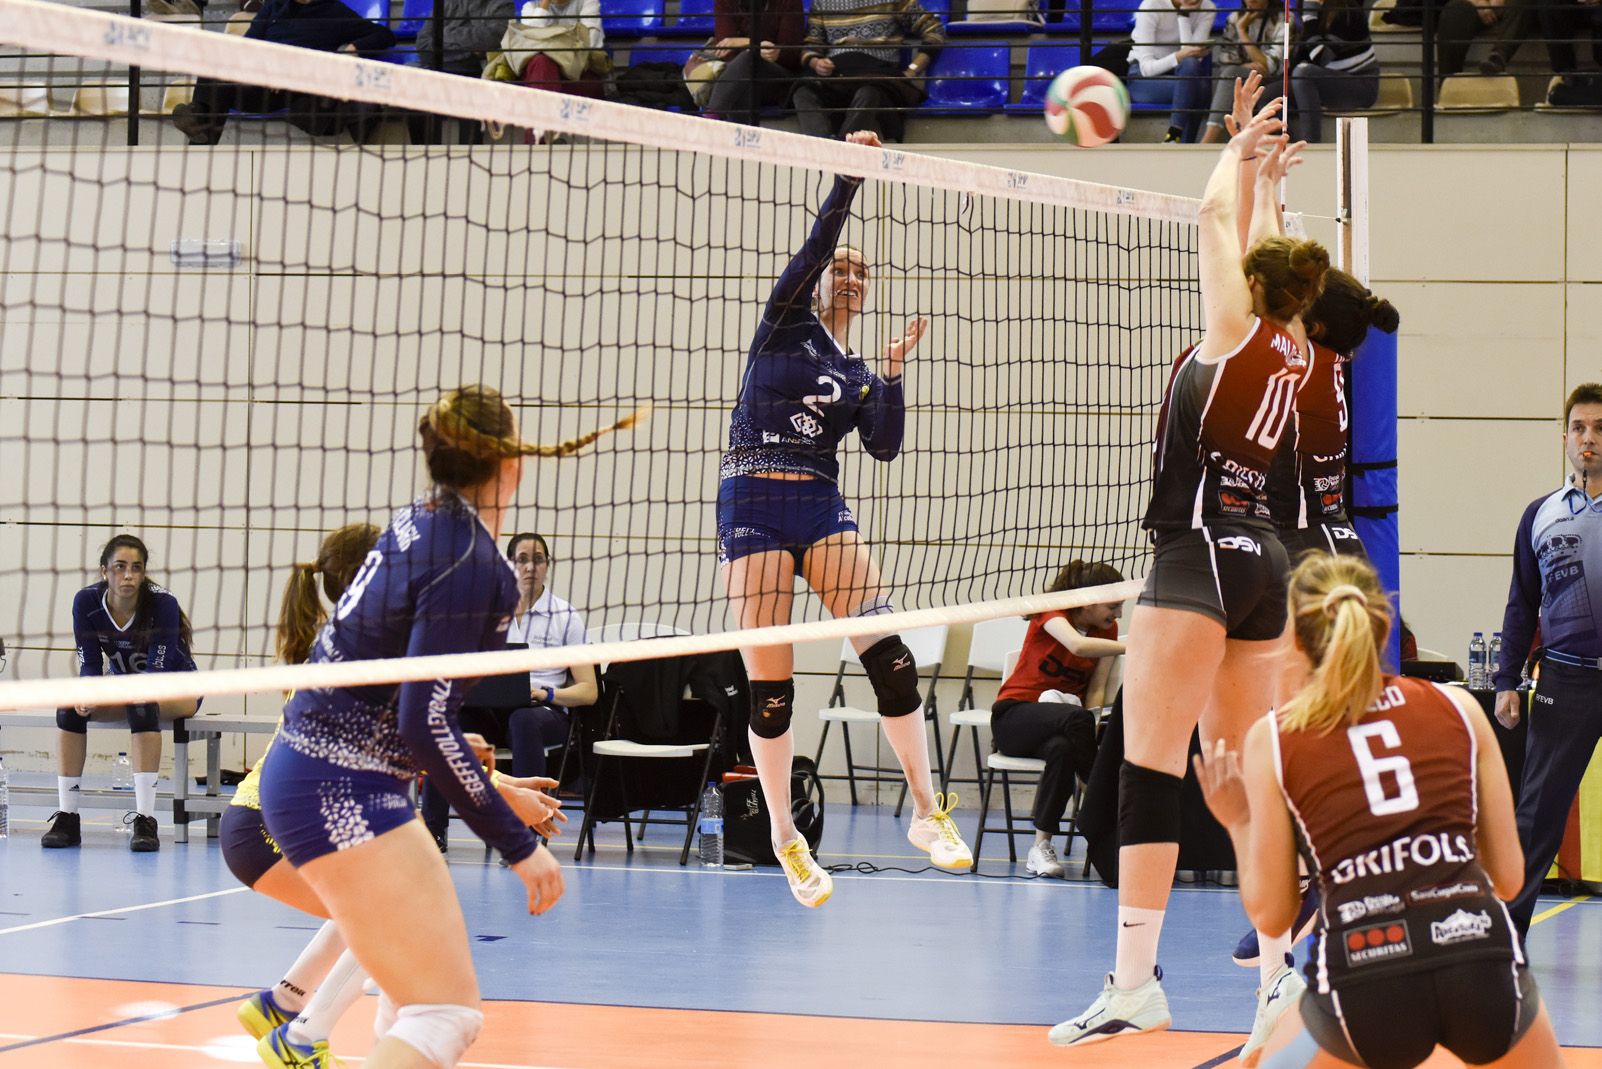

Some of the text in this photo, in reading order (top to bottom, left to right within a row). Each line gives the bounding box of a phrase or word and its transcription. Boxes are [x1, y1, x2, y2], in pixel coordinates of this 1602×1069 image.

[803, 376, 841, 417] 2
[1245, 367, 1301, 450] 10
[1217, 536, 1262, 557] DSV
[1332, 527, 1359, 540] DS
[1347, 720, 1420, 816] 6
[280, 979, 306, 997] rrea
